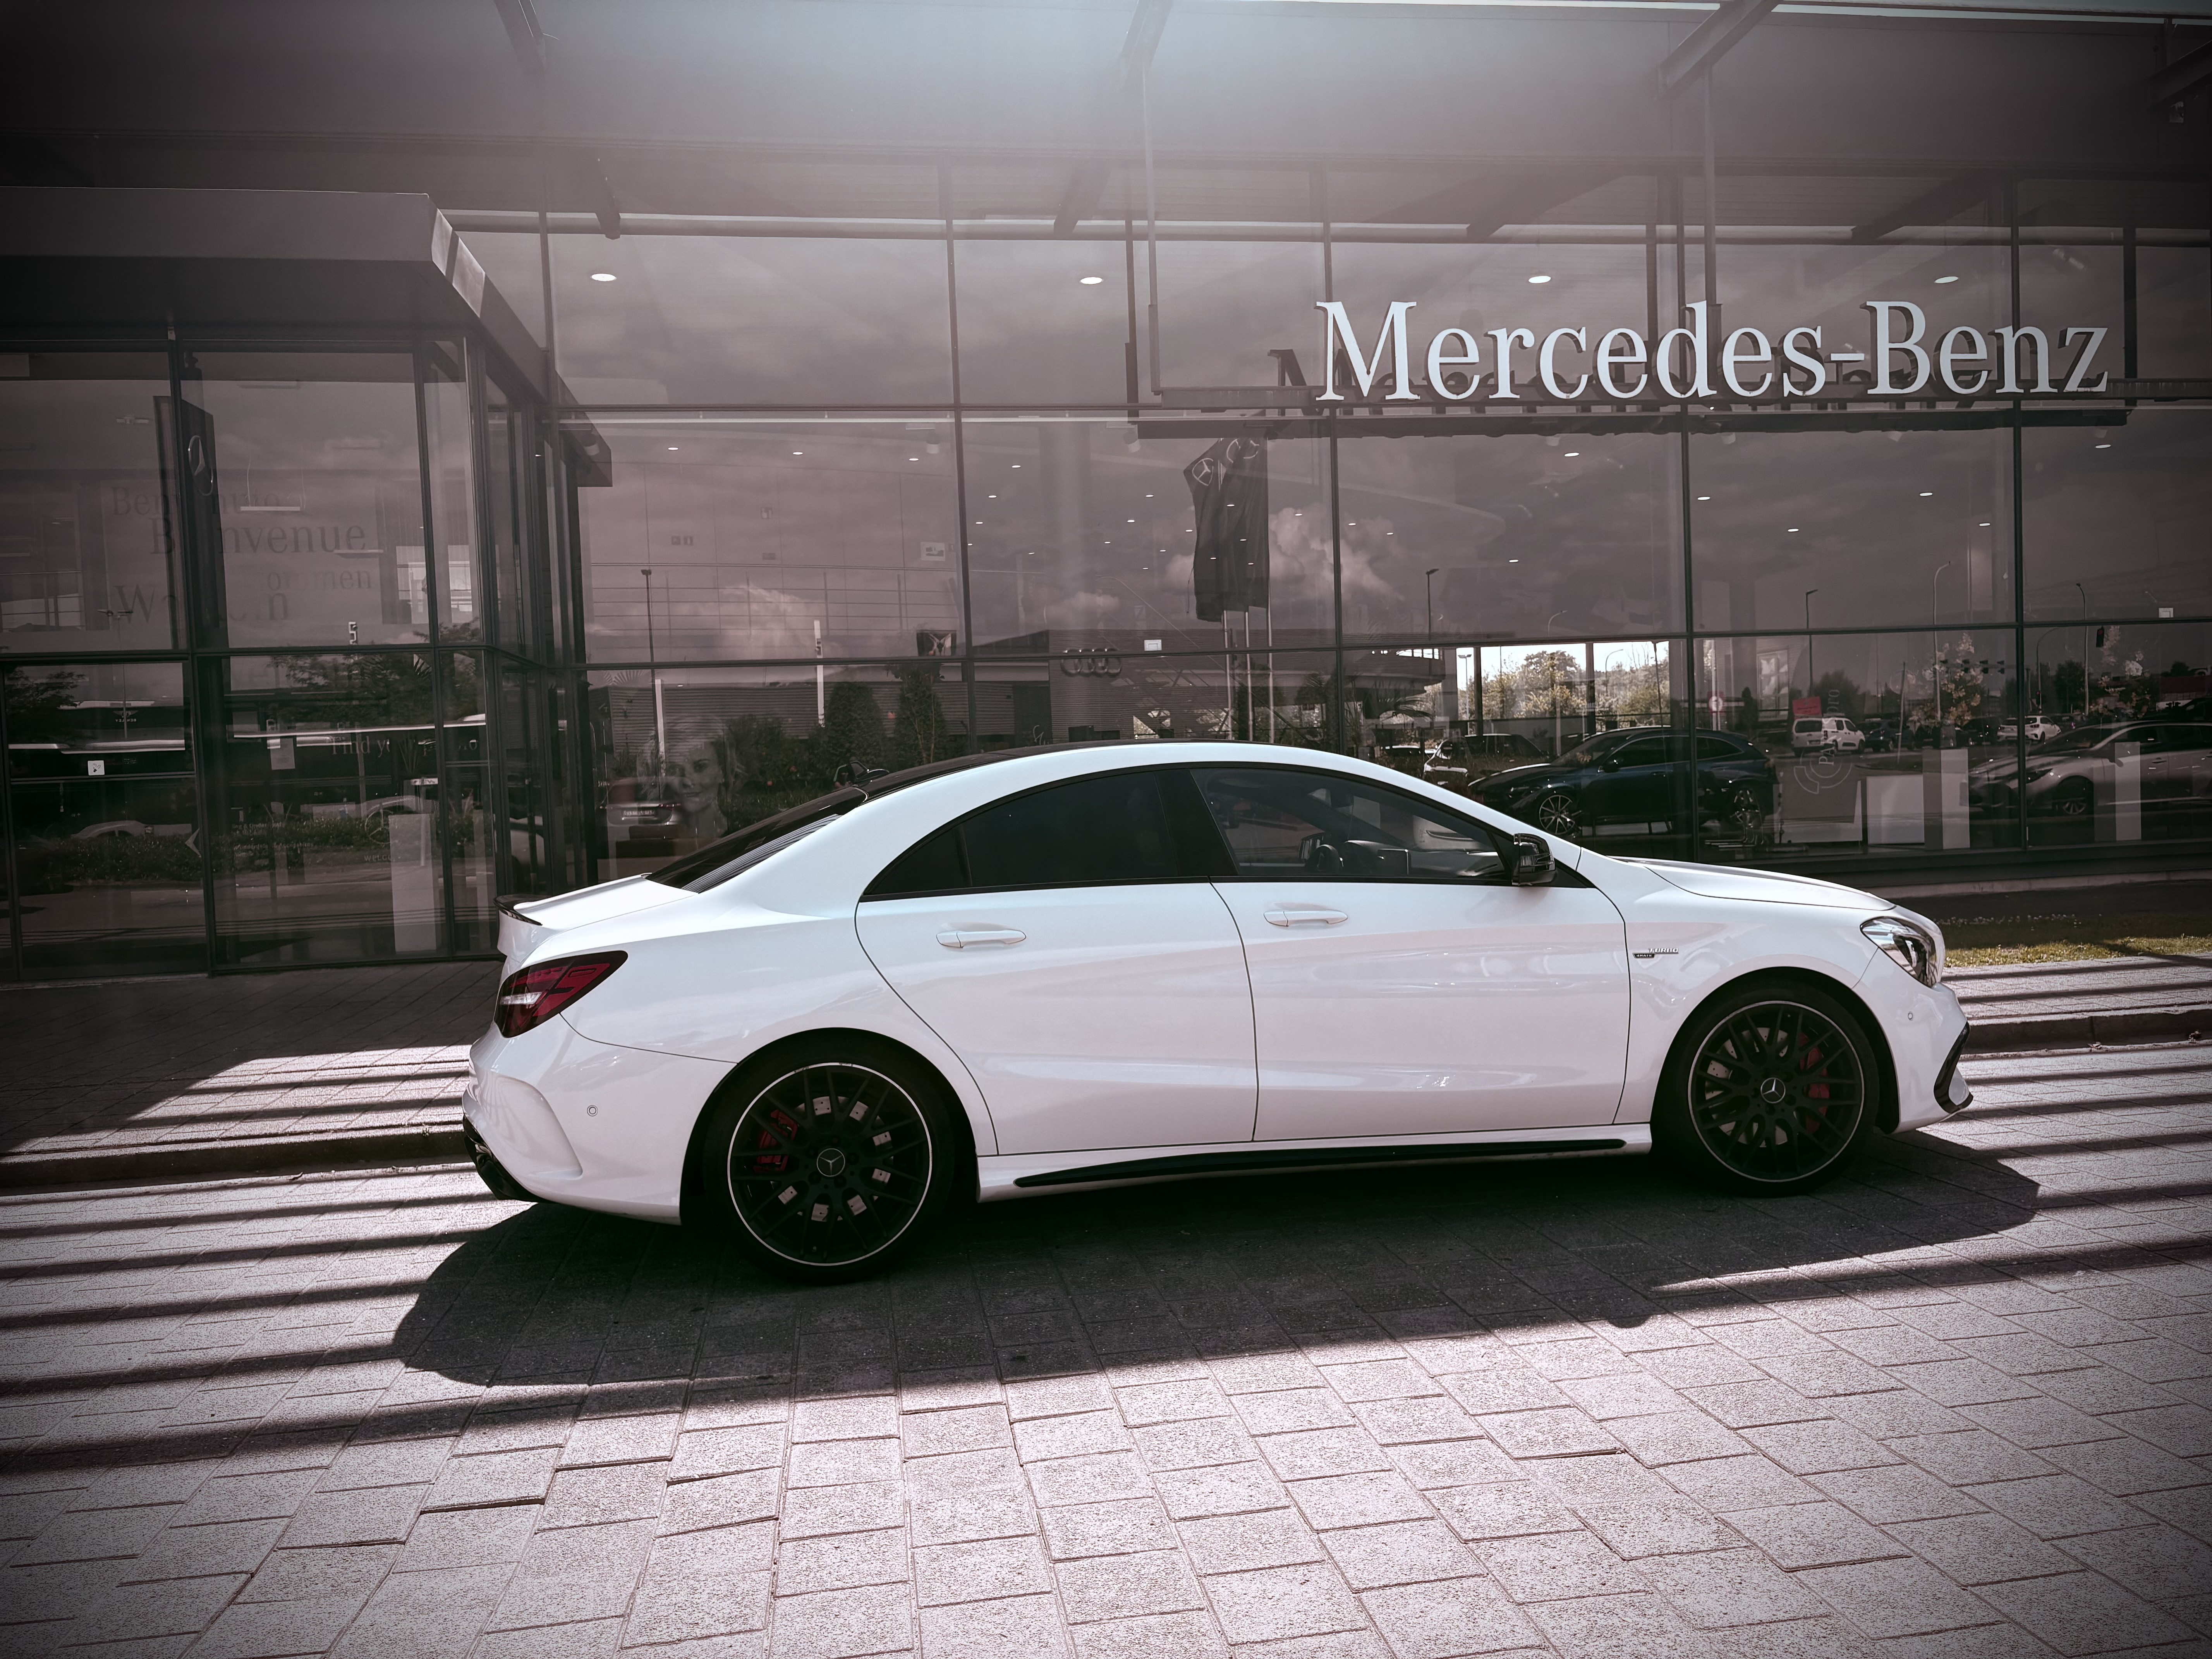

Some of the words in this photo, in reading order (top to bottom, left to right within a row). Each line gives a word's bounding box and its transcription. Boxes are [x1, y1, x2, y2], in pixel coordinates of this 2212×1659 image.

[1315, 300, 2109, 401] Mercedes-Benz
[111, 486, 280, 516] Bennuto
[148, 518, 366, 554] Bnvenue
